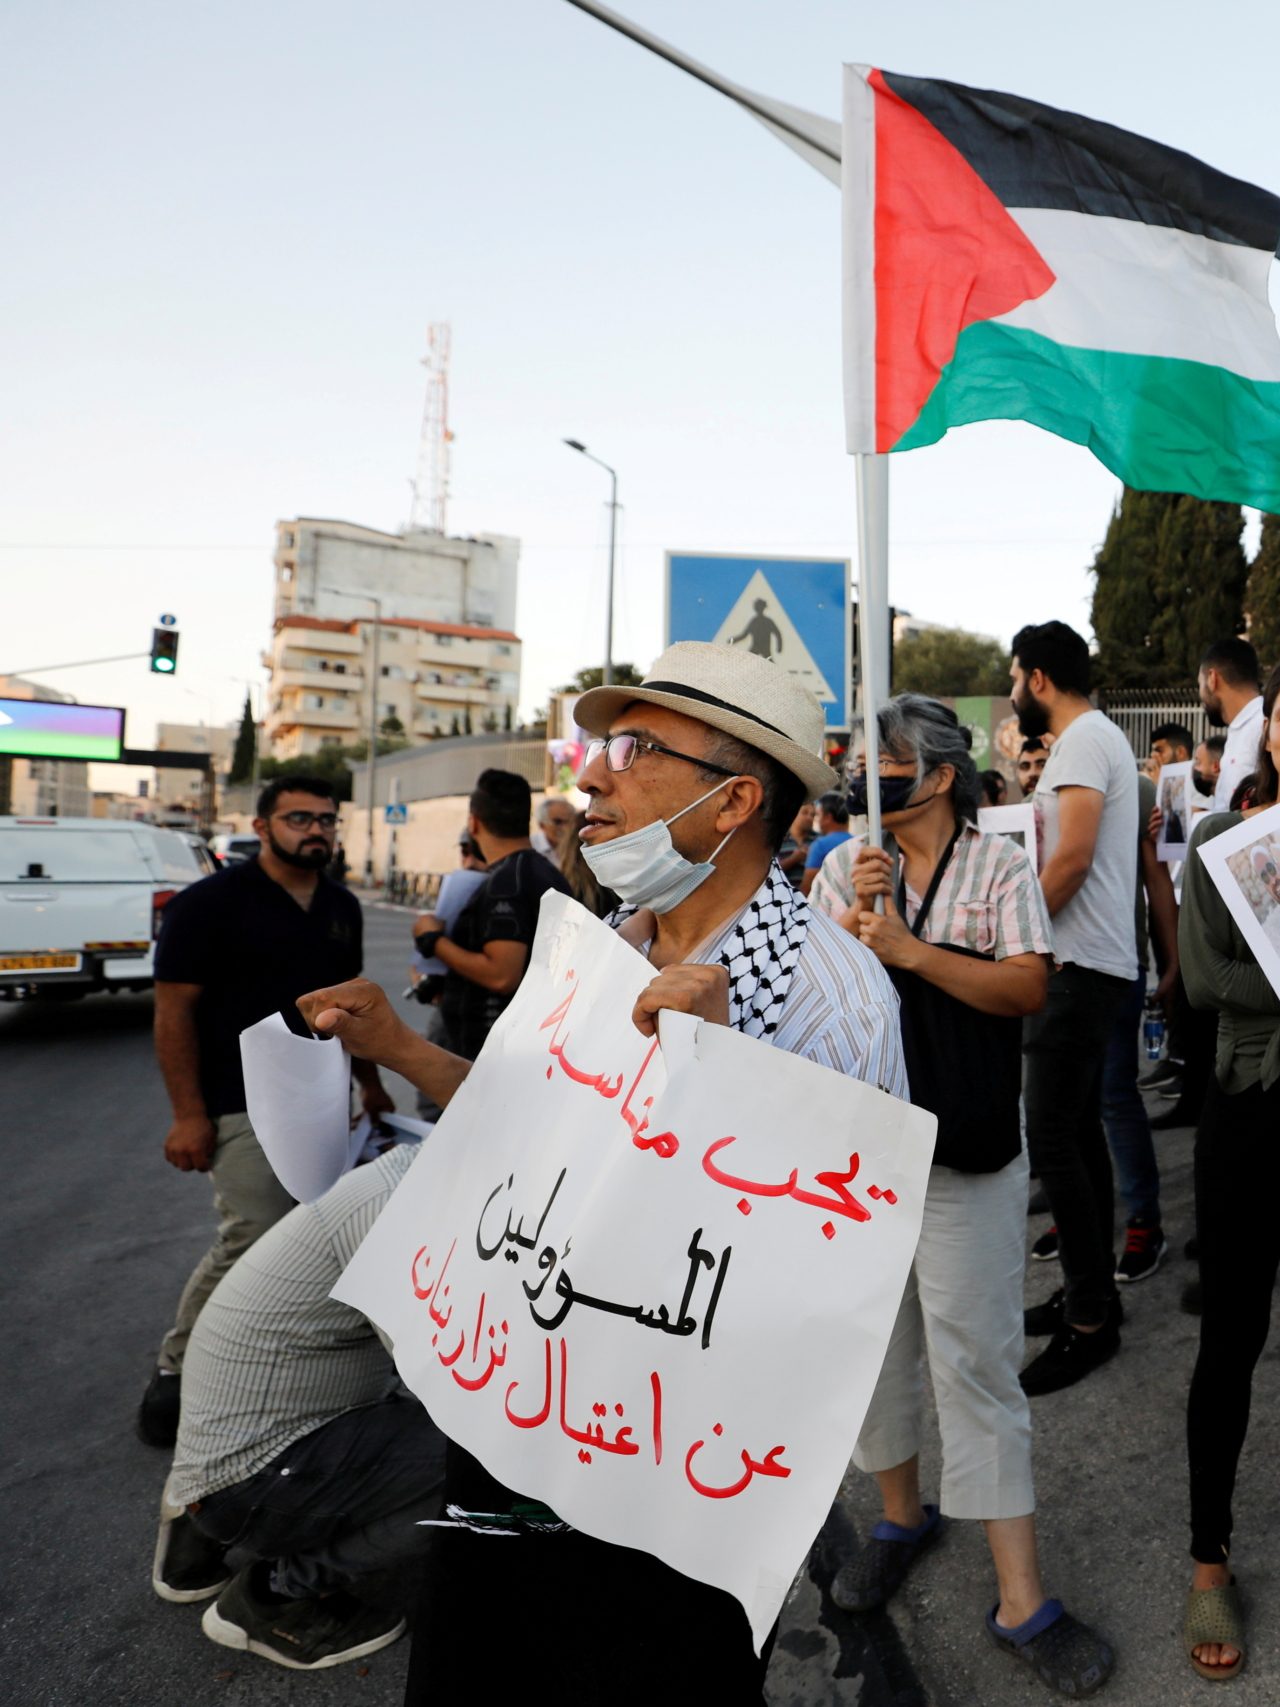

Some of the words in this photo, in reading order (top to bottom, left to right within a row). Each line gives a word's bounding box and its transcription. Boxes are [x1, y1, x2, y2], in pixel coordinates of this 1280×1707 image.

[702, 1136, 898, 1240] يجب
[476, 1167, 731, 1350] المسؤولين
[437, 1291, 509, 1391] نزار
[504, 1337, 662, 1466] اغتيال
[685, 1422, 791, 1499] عن
